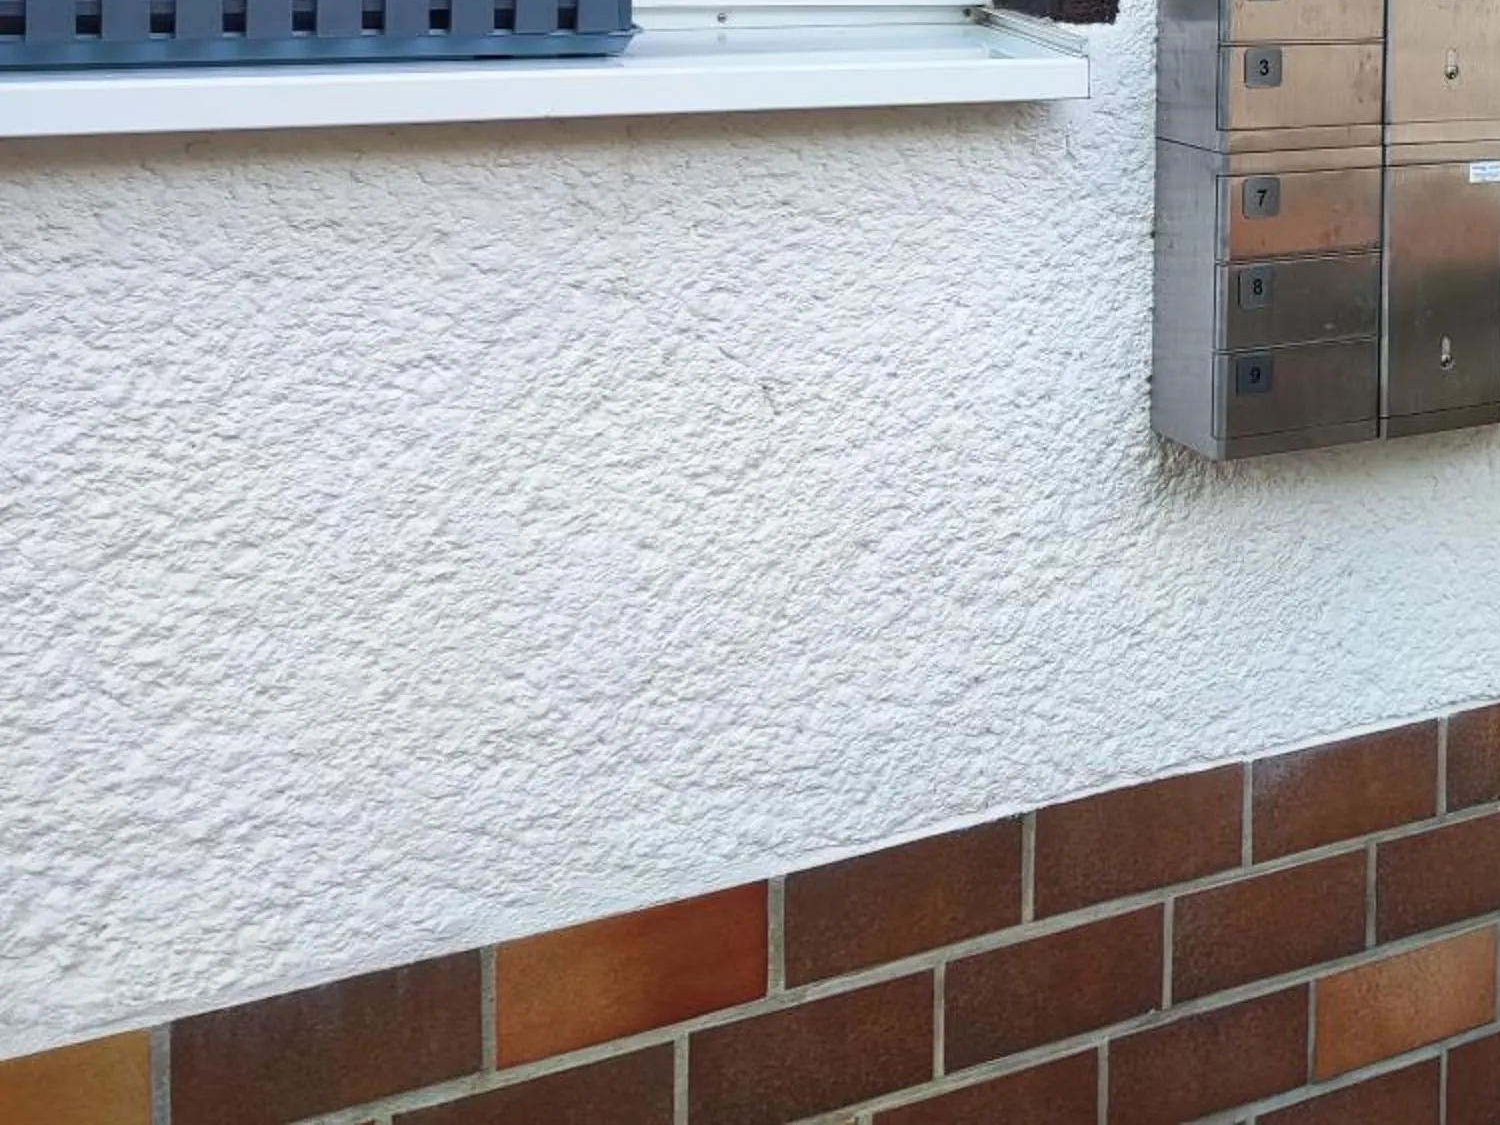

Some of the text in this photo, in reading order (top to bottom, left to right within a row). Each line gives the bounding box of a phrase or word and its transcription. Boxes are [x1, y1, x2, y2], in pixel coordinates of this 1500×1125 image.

[1260, 59, 1269, 76] 3
[1257, 189, 1268, 207] 7
[1253, 279, 1262, 295] 8
